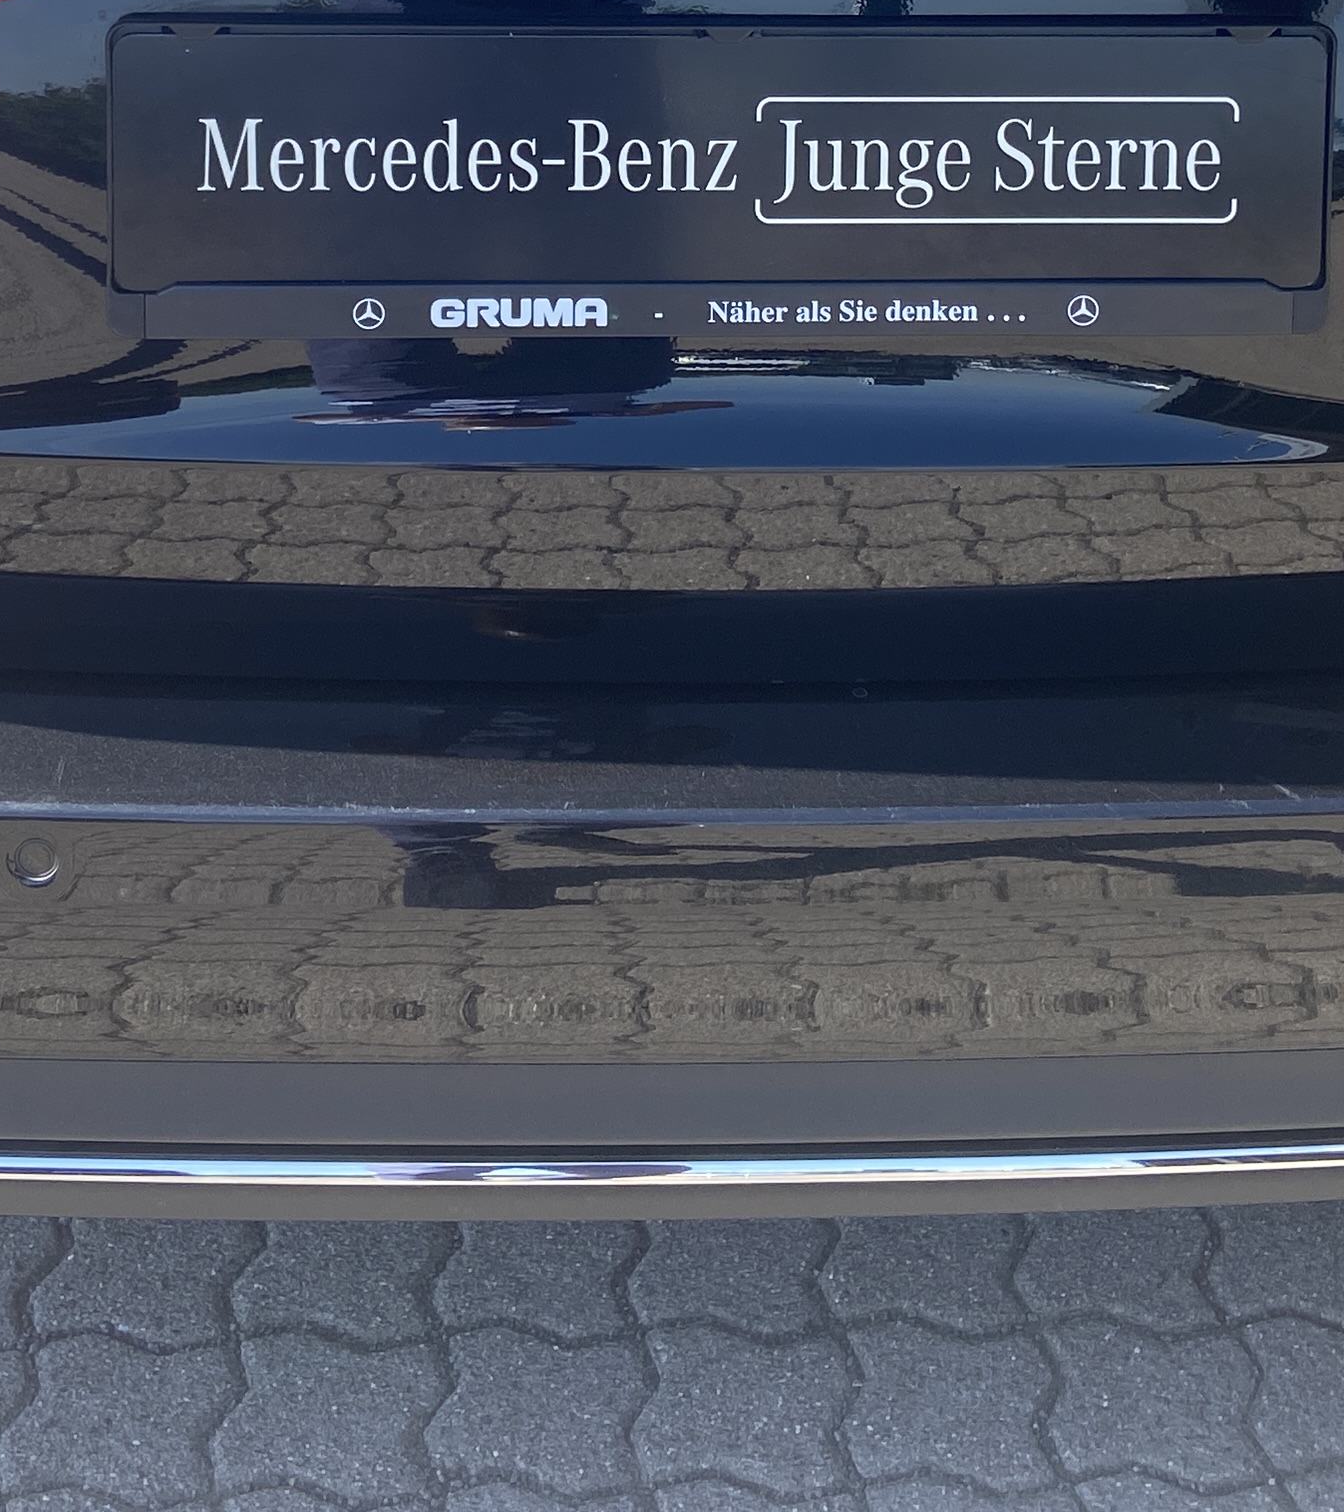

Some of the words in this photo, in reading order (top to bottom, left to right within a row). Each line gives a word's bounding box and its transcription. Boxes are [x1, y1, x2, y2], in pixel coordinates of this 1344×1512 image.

[196, 118, 738, 192] Mercedes-Benz
[773, 119, 971, 209] Junge
[995, 118, 1221, 192] Sterne
[430, 297, 608, 328] GRUMA
[707, 300, 789, 323] Näher
[795, 300, 832, 323] als
[839, 299, 878, 323] Sie
[885, 299, 979, 322] denken
